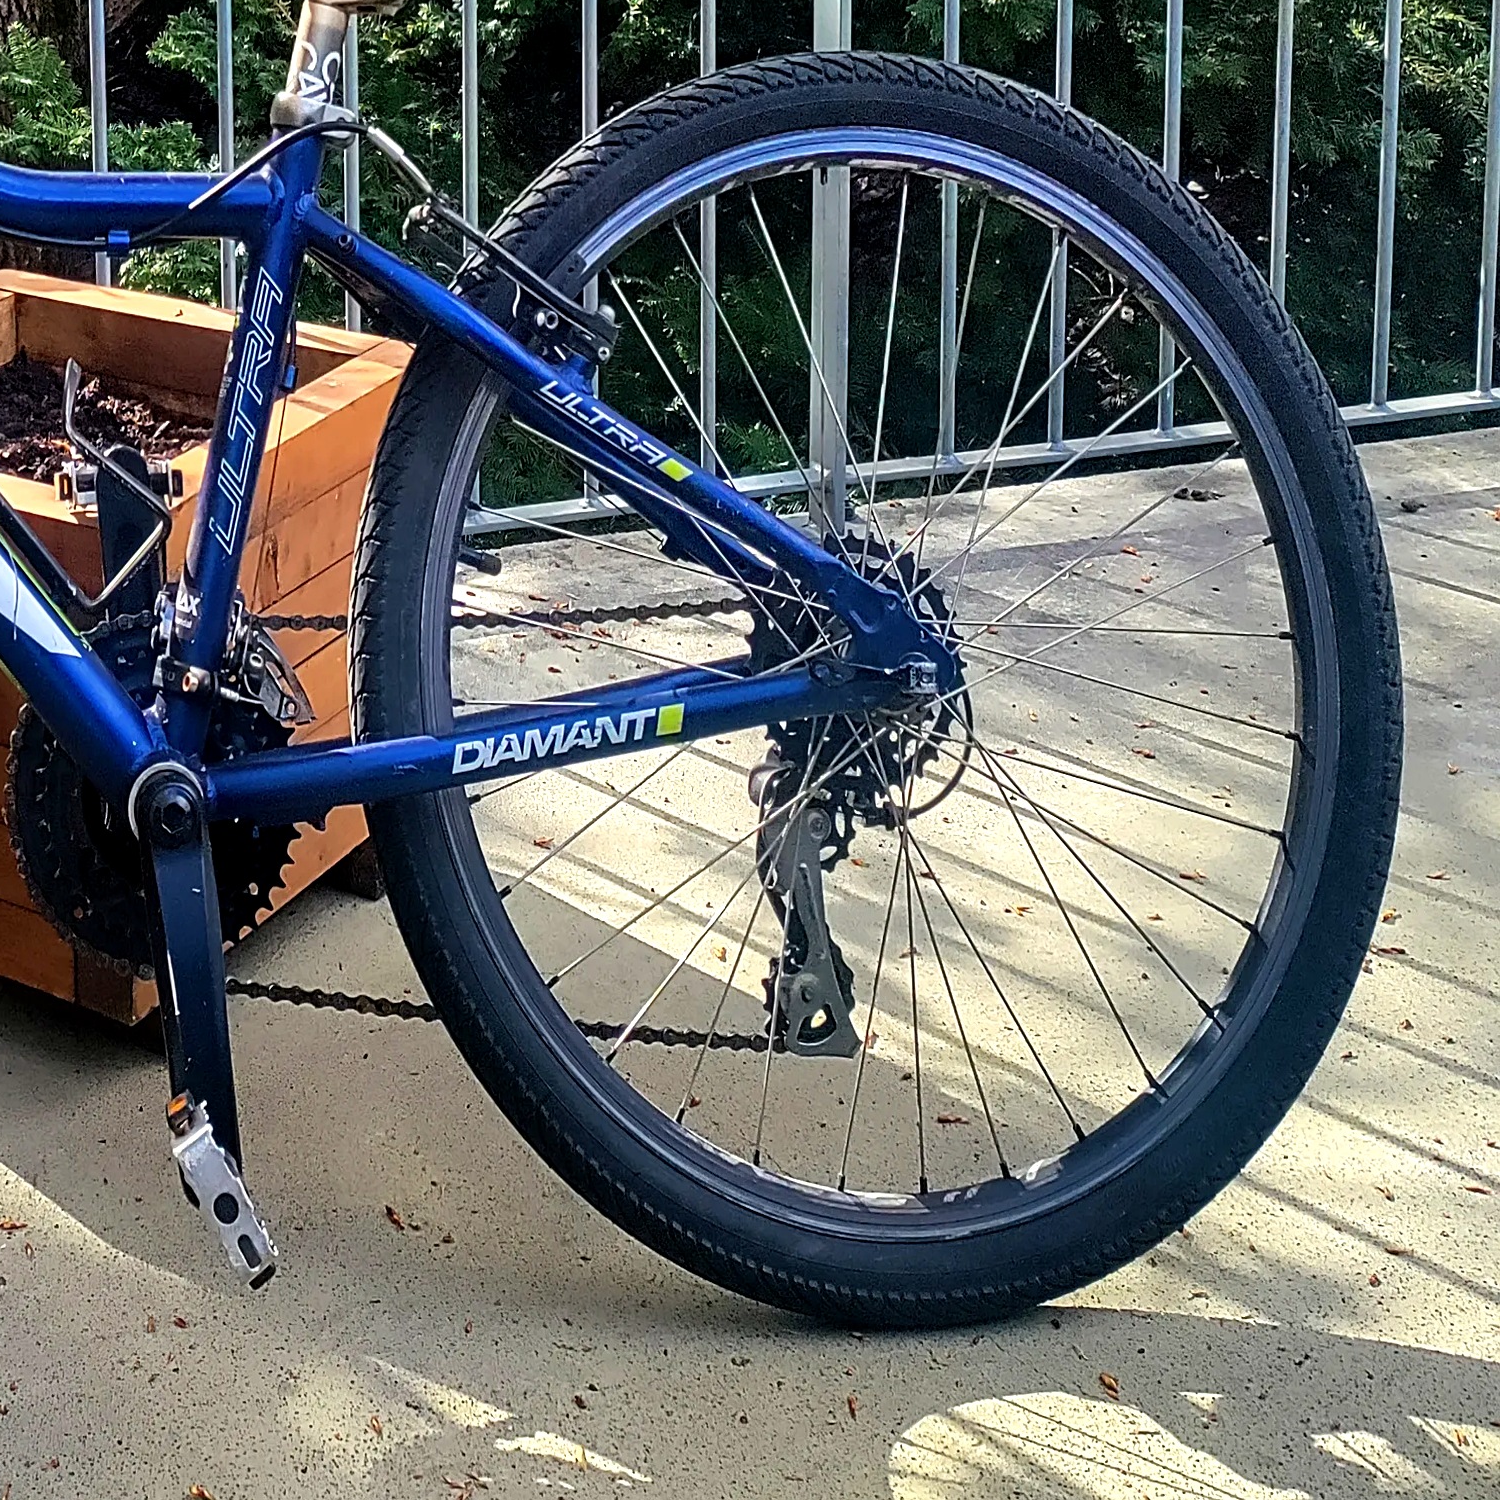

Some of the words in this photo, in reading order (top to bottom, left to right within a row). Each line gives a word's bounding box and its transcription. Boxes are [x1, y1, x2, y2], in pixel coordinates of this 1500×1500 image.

[209, 266, 284, 556] ULTRA
[539, 379, 669, 468] ULTRA
[451, 707, 657, 775] DIAMANT
